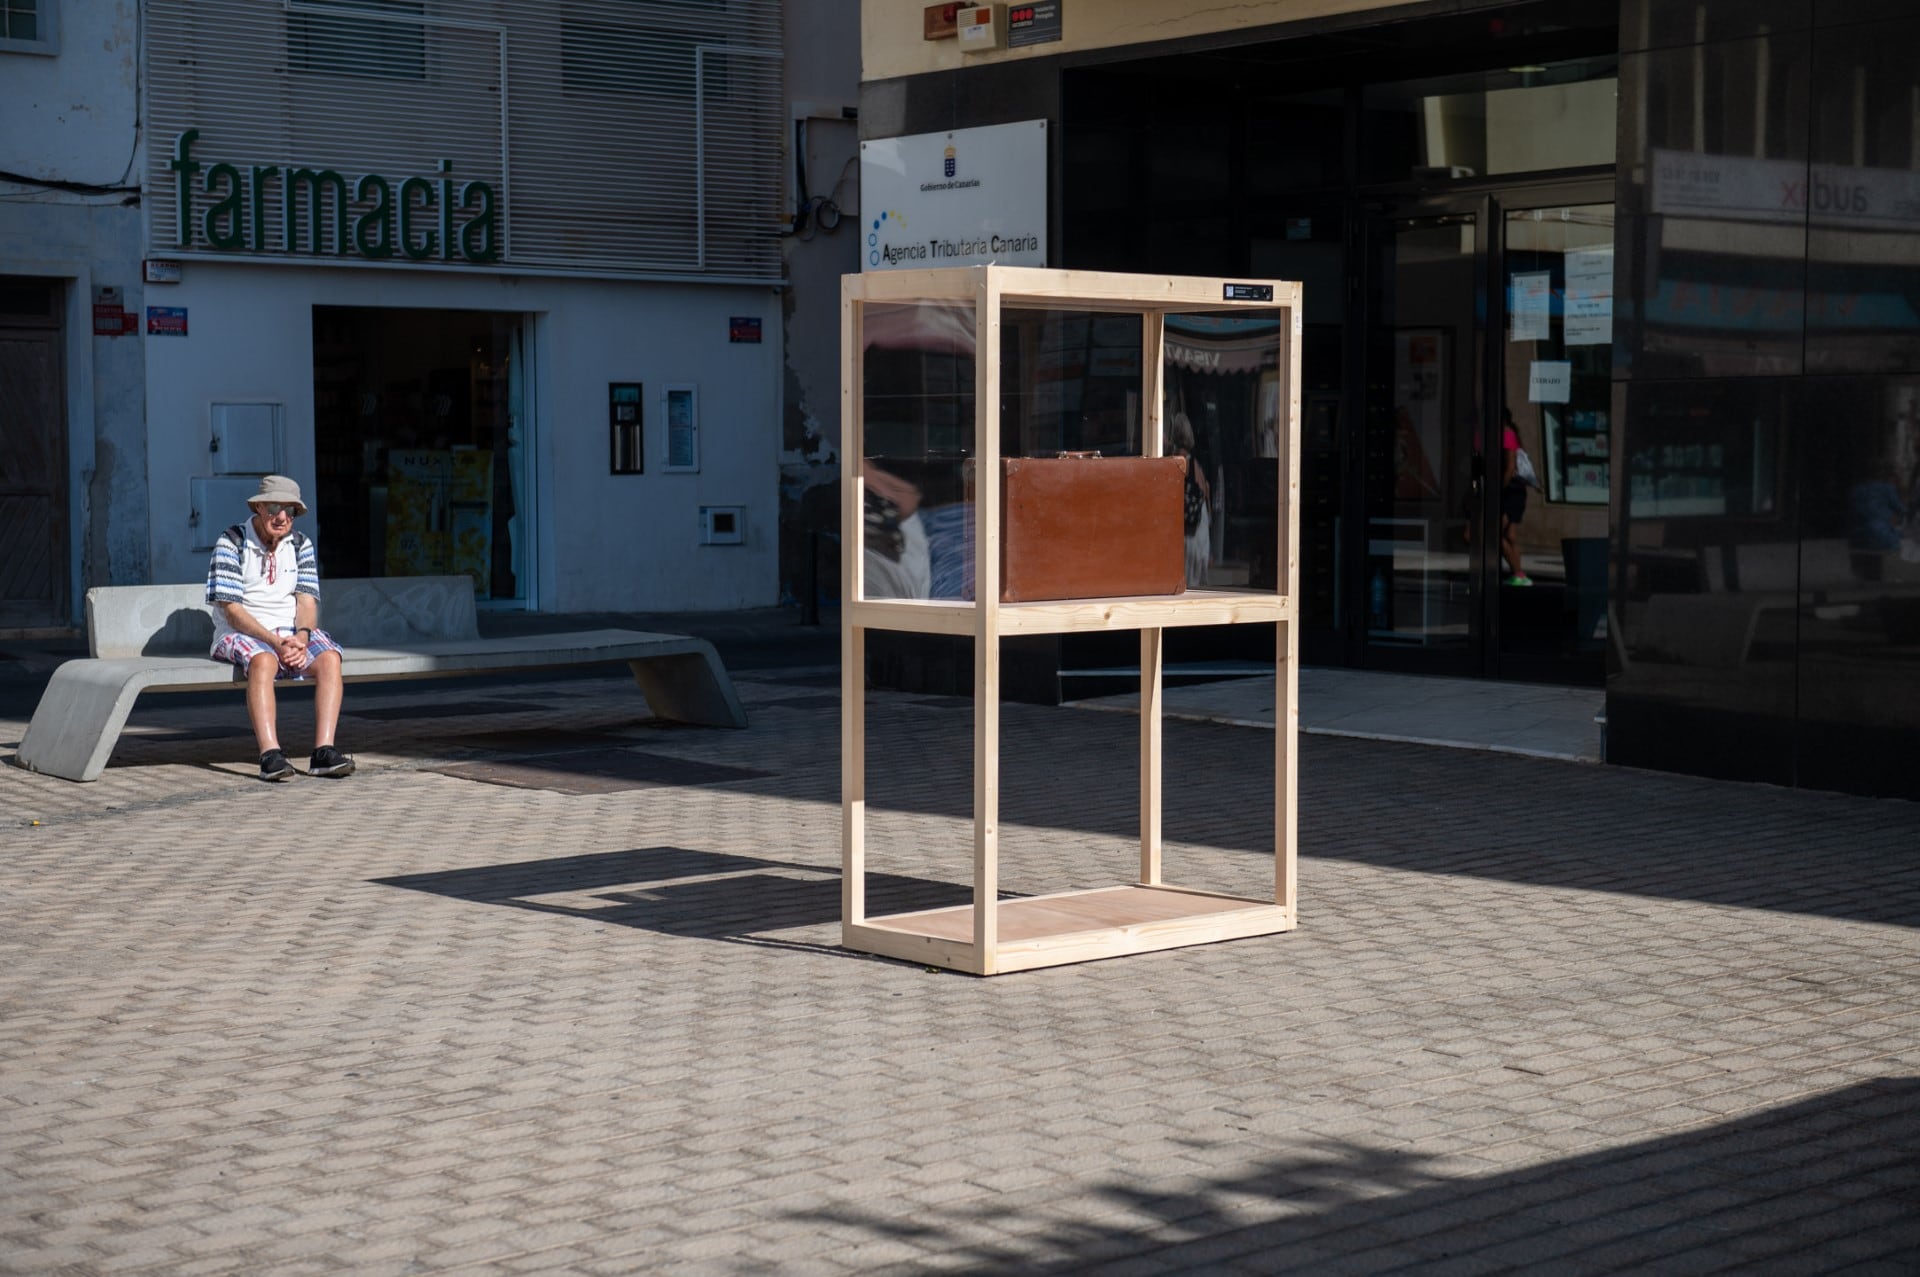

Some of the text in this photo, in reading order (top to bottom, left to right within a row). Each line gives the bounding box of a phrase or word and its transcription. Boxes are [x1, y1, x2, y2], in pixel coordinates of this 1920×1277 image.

[171, 129, 499, 262] farmacia
[920, 178, 980, 192] Gobierno de Canarias
[882, 233, 1038, 265] Agencia Tributaria Canaria
